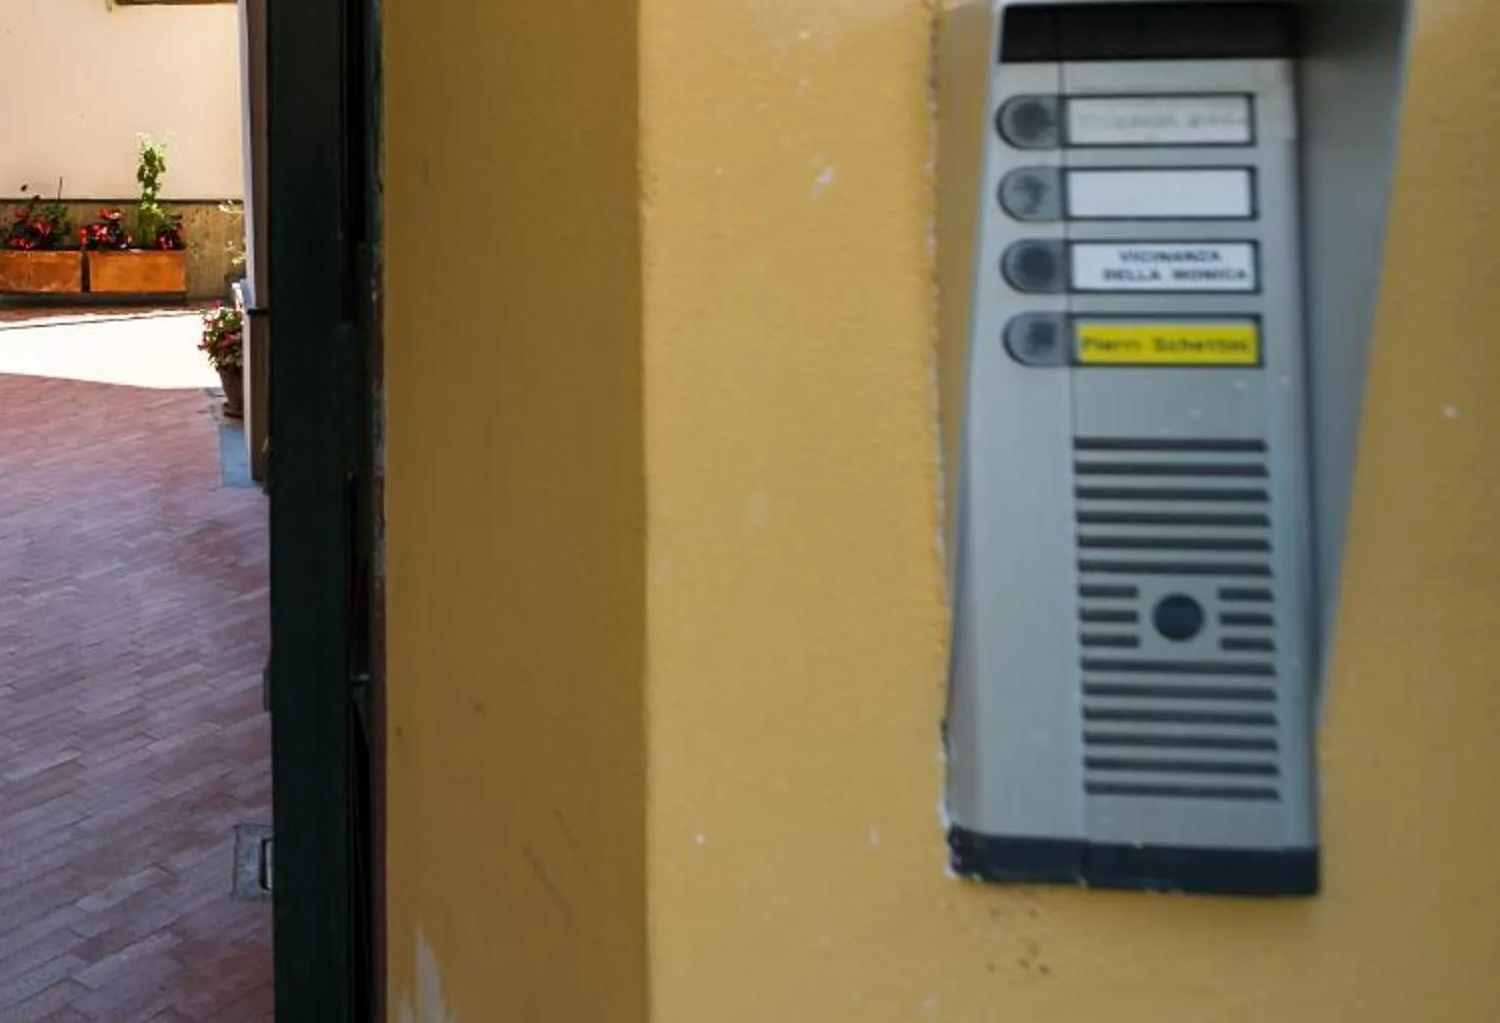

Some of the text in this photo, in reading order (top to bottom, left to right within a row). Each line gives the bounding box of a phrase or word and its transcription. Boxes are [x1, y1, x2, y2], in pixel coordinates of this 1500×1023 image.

[1117, 248, 1221, 263] VICINANZA
[1102, 267, 1247, 282] DELLA MONICA
